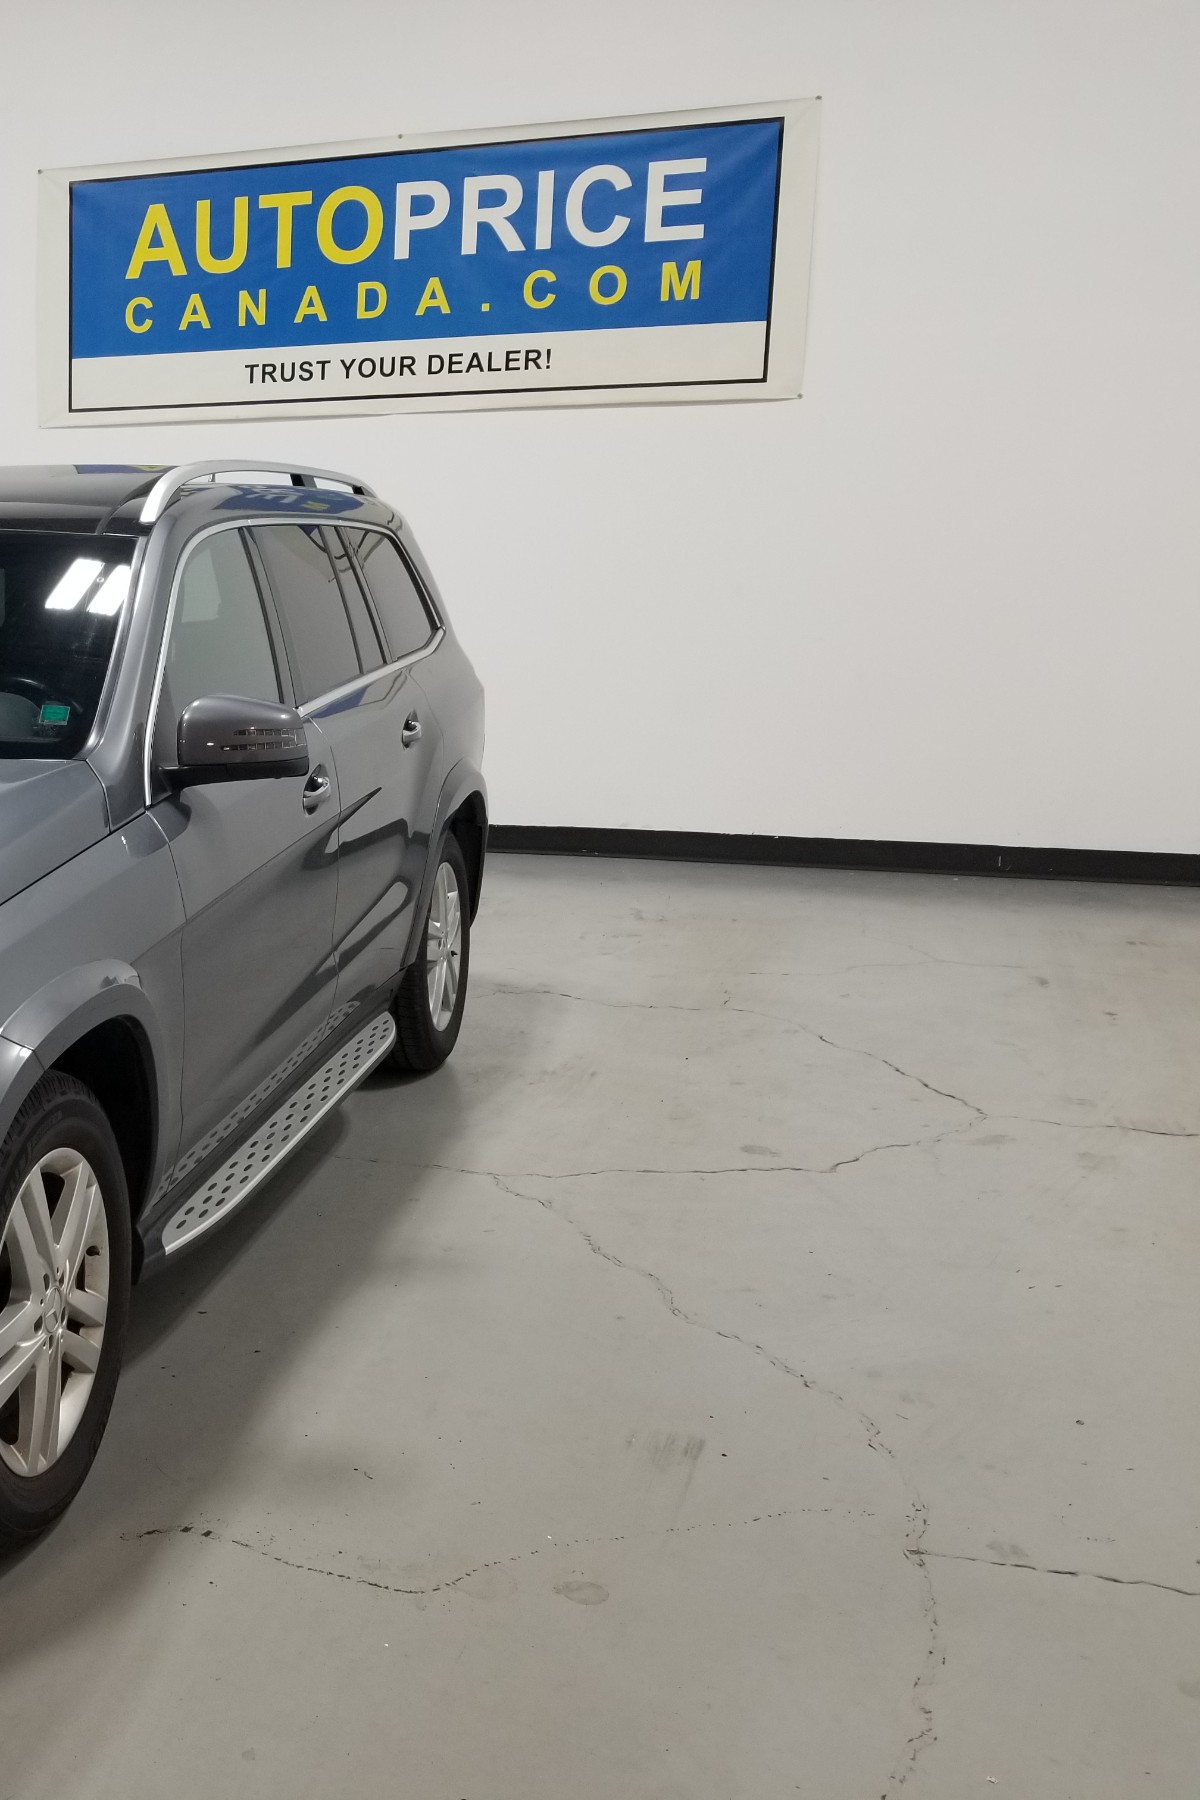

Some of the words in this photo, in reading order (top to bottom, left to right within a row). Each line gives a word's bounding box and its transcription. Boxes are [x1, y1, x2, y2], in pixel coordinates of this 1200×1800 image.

[125, 157, 707, 280] AUTOPRICE
[125, 259, 701, 334] CANADA.COM
[245, 359, 331, 384] TRUST
[340, 355, 417, 380] YOUR
[427, 348, 552, 375] DEALER!
